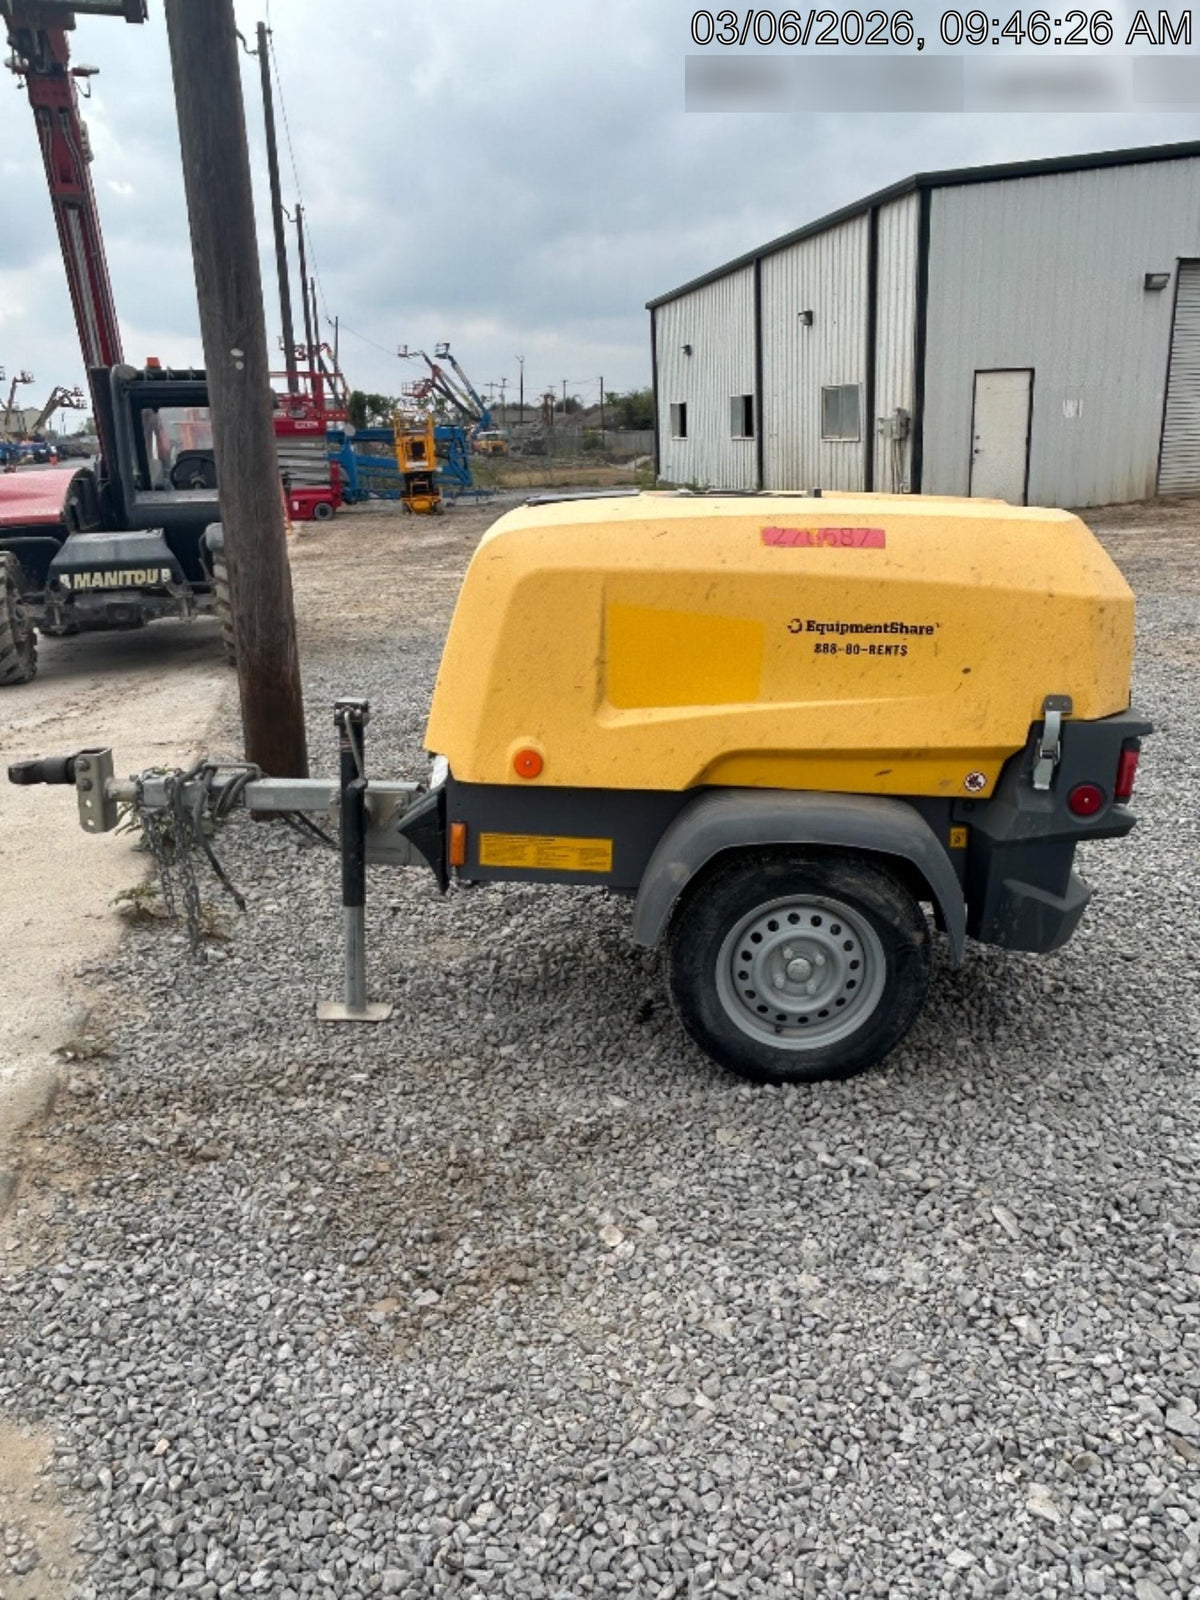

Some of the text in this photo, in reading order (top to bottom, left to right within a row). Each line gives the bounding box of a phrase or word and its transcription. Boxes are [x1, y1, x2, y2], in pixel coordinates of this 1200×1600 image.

[73, 568, 159, 589] MANITOU
[806, 620, 934, 636] EquipmentShare
[813, 643, 908, 657] 888-80-RENTS
